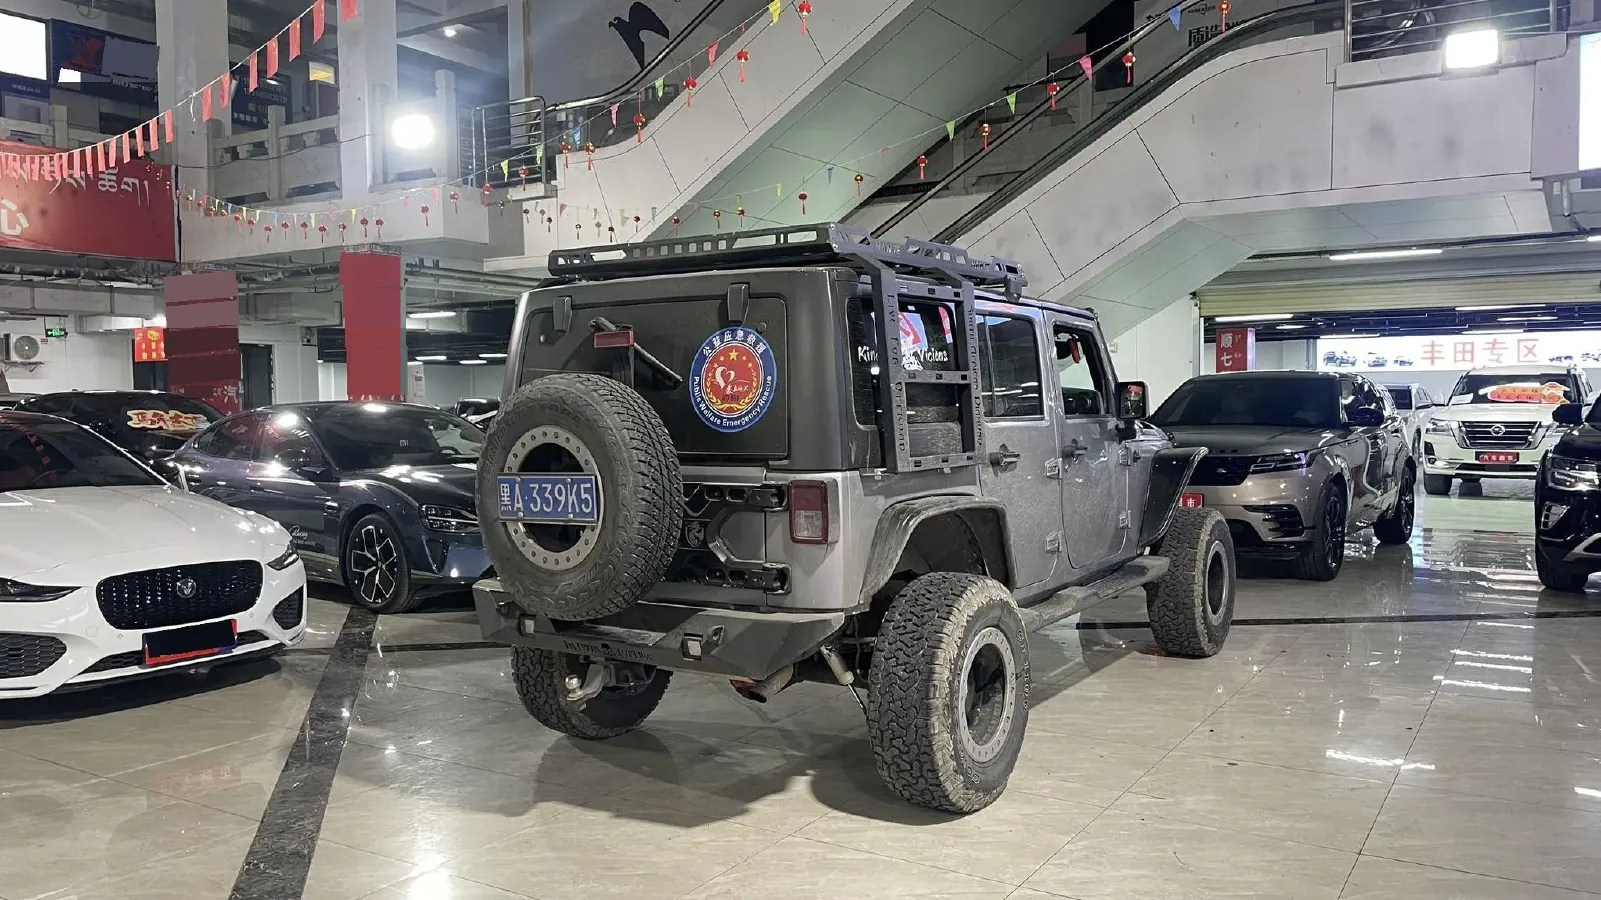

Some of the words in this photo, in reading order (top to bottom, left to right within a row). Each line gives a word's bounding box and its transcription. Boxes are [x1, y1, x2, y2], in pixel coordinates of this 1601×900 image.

[1420, 338, 1540, 366] 丰田专区
[693, 376, 701, 402] Public
[699, 401, 722, 425] Welfare
[722, 405, 761, 427] Emergency
[759, 375, 772, 407] Rescue
